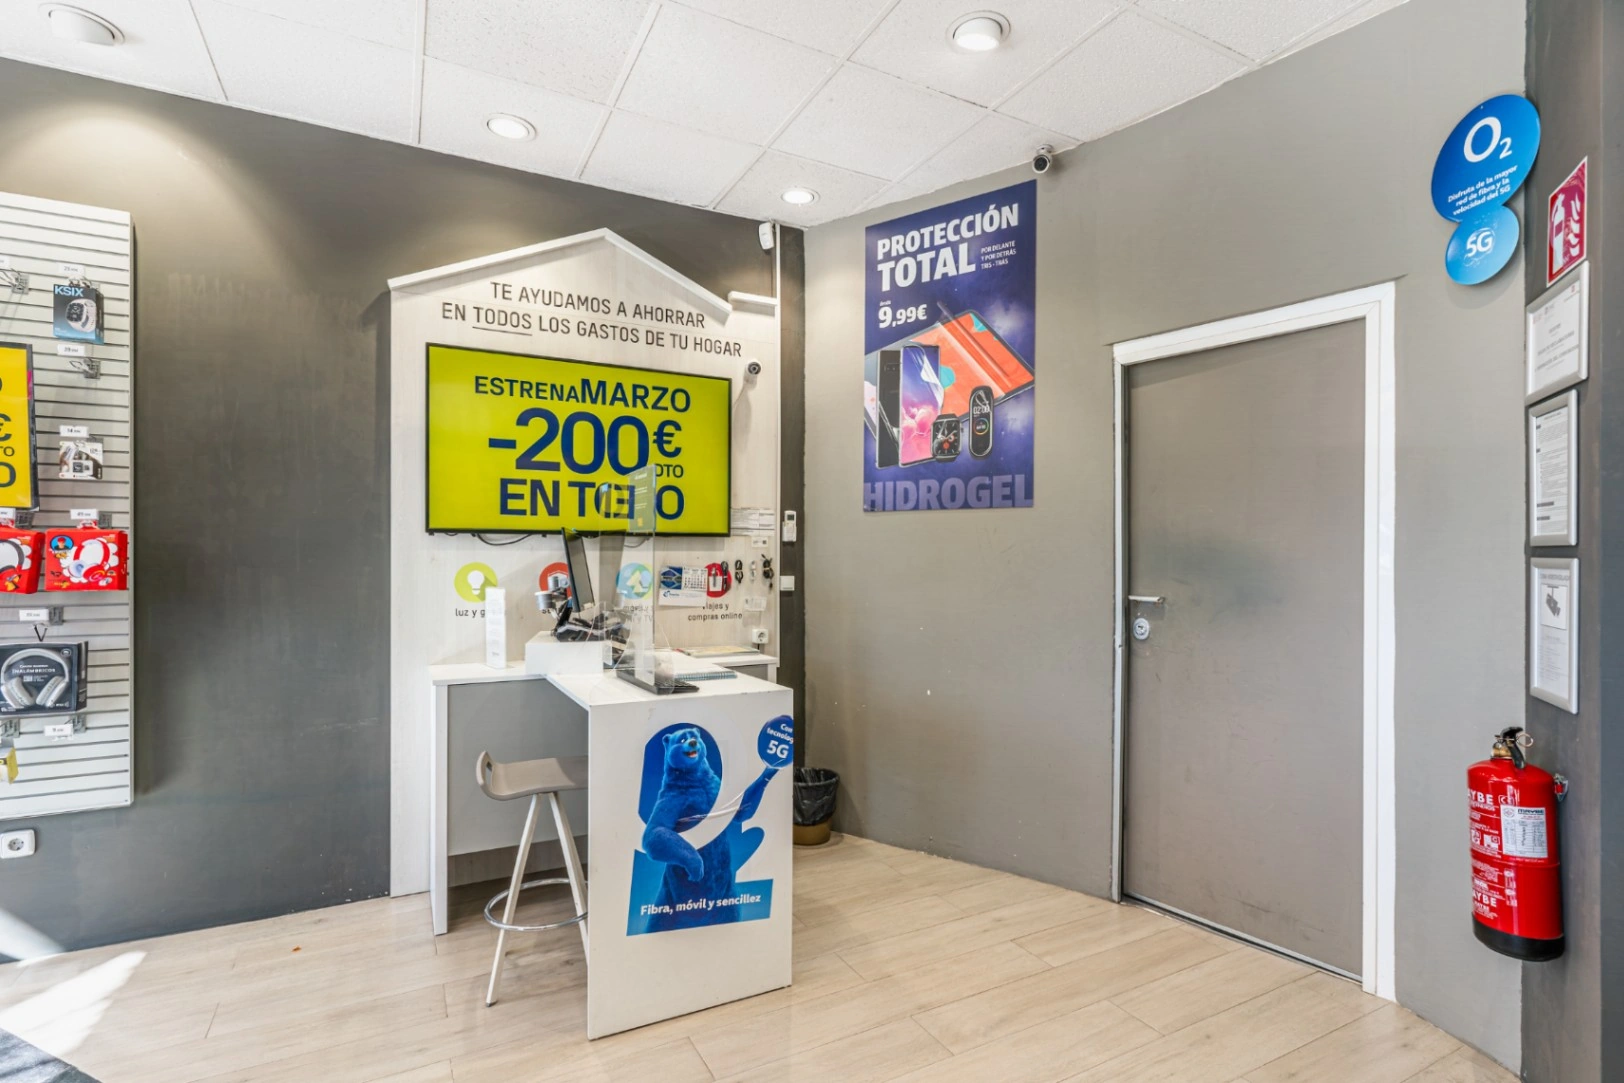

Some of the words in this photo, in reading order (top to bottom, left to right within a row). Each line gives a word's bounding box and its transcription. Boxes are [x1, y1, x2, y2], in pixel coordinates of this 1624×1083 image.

[1448, 186, 1475, 203] Disfruta
[1476, 181, 1485, 189] de
[1494, 165, 1518, 180] mayor
[1456, 196, 1468, 206] red
[1469, 193, 1478, 201] de
[1479, 184, 1496, 197] fibra
[1453, 195, 1487, 216] velocidad
[1487, 189, 1499, 201] del
[1500, 184, 1511, 195] 5G
[877, 203, 1019, 260] PROTECCIÓN
[1466, 230, 1494, 257] 5G
[981, 246, 992, 254] POR
[992, 240, 1016, 252] DELANTE
[985, 253, 996, 261] POR
[877, 242, 976, 292] TOTAL
[54, 286, 84, 297] KSIX
[490, 282, 512, 301] TE
[518, 287, 611, 315] AYUDAMOS
[616, 301, 627, 317] A
[632, 303, 705, 329] AHORRAR
[878, 304, 928, 328] 9,99€
[442, 302, 466, 321] EN
[473, 306, 532, 330] TODOS
[538, 315, 570, 335] LOS
[576, 320, 640, 344] GASTOS
[645, 329, 665, 347] DE
[669, 332, 688, 351] TU
[693, 337, 742, 358] HOGAR
[500, 478, 560, 517] EN
[864, 474, 1034, 510] HIDROGEL
[455, 608, 469, 617] luz
[471, 609, 478, 618] y
[688, 614, 719, 622] compras
[720, 612, 742, 620] online
[702, 602, 723, 611] iajes
[725, 602, 729, 610] y
[766, 739, 789, 759] 5G
[640, 904, 674, 916] Fibra,
[676, 899, 706, 912] móvil
[707, 900, 715, 911] y
[716, 894, 761, 907] sencillez
